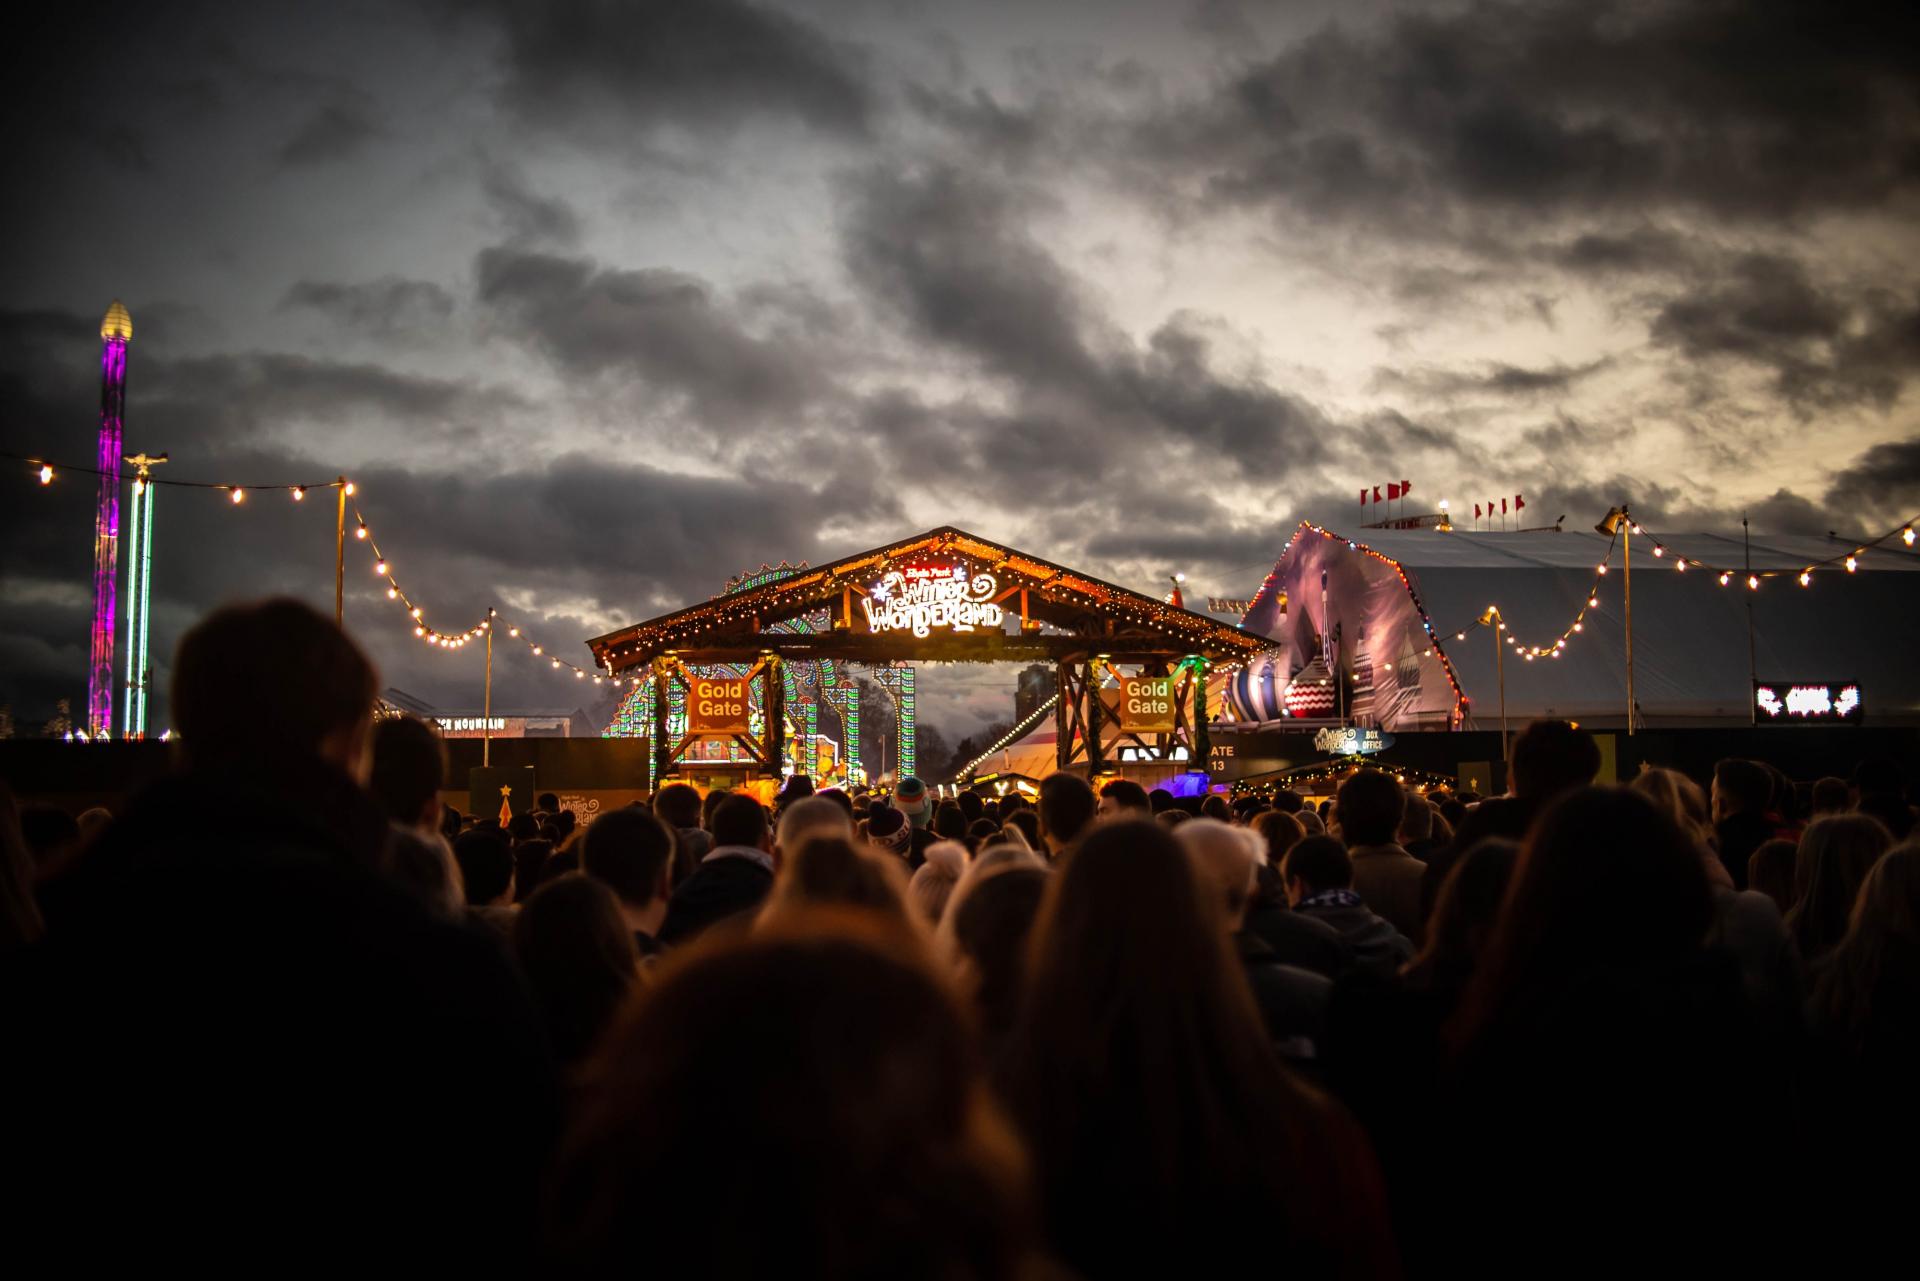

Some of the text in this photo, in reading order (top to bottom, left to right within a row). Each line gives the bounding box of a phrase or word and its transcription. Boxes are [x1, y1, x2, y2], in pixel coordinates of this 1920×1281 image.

[698, 682, 742, 698] Gold
[1127, 681, 1168, 697] Gold
[699, 700, 742, 716] Gate
[1127, 699, 1168, 714] Gate
[454, 717, 505, 731] MOUNTAIN
[1366, 731, 1378, 739] BOX
[1211, 746, 1234, 756] ATE
[1362, 741, 1382, 749] OFFICE
[1211, 760, 1225, 771] 13
